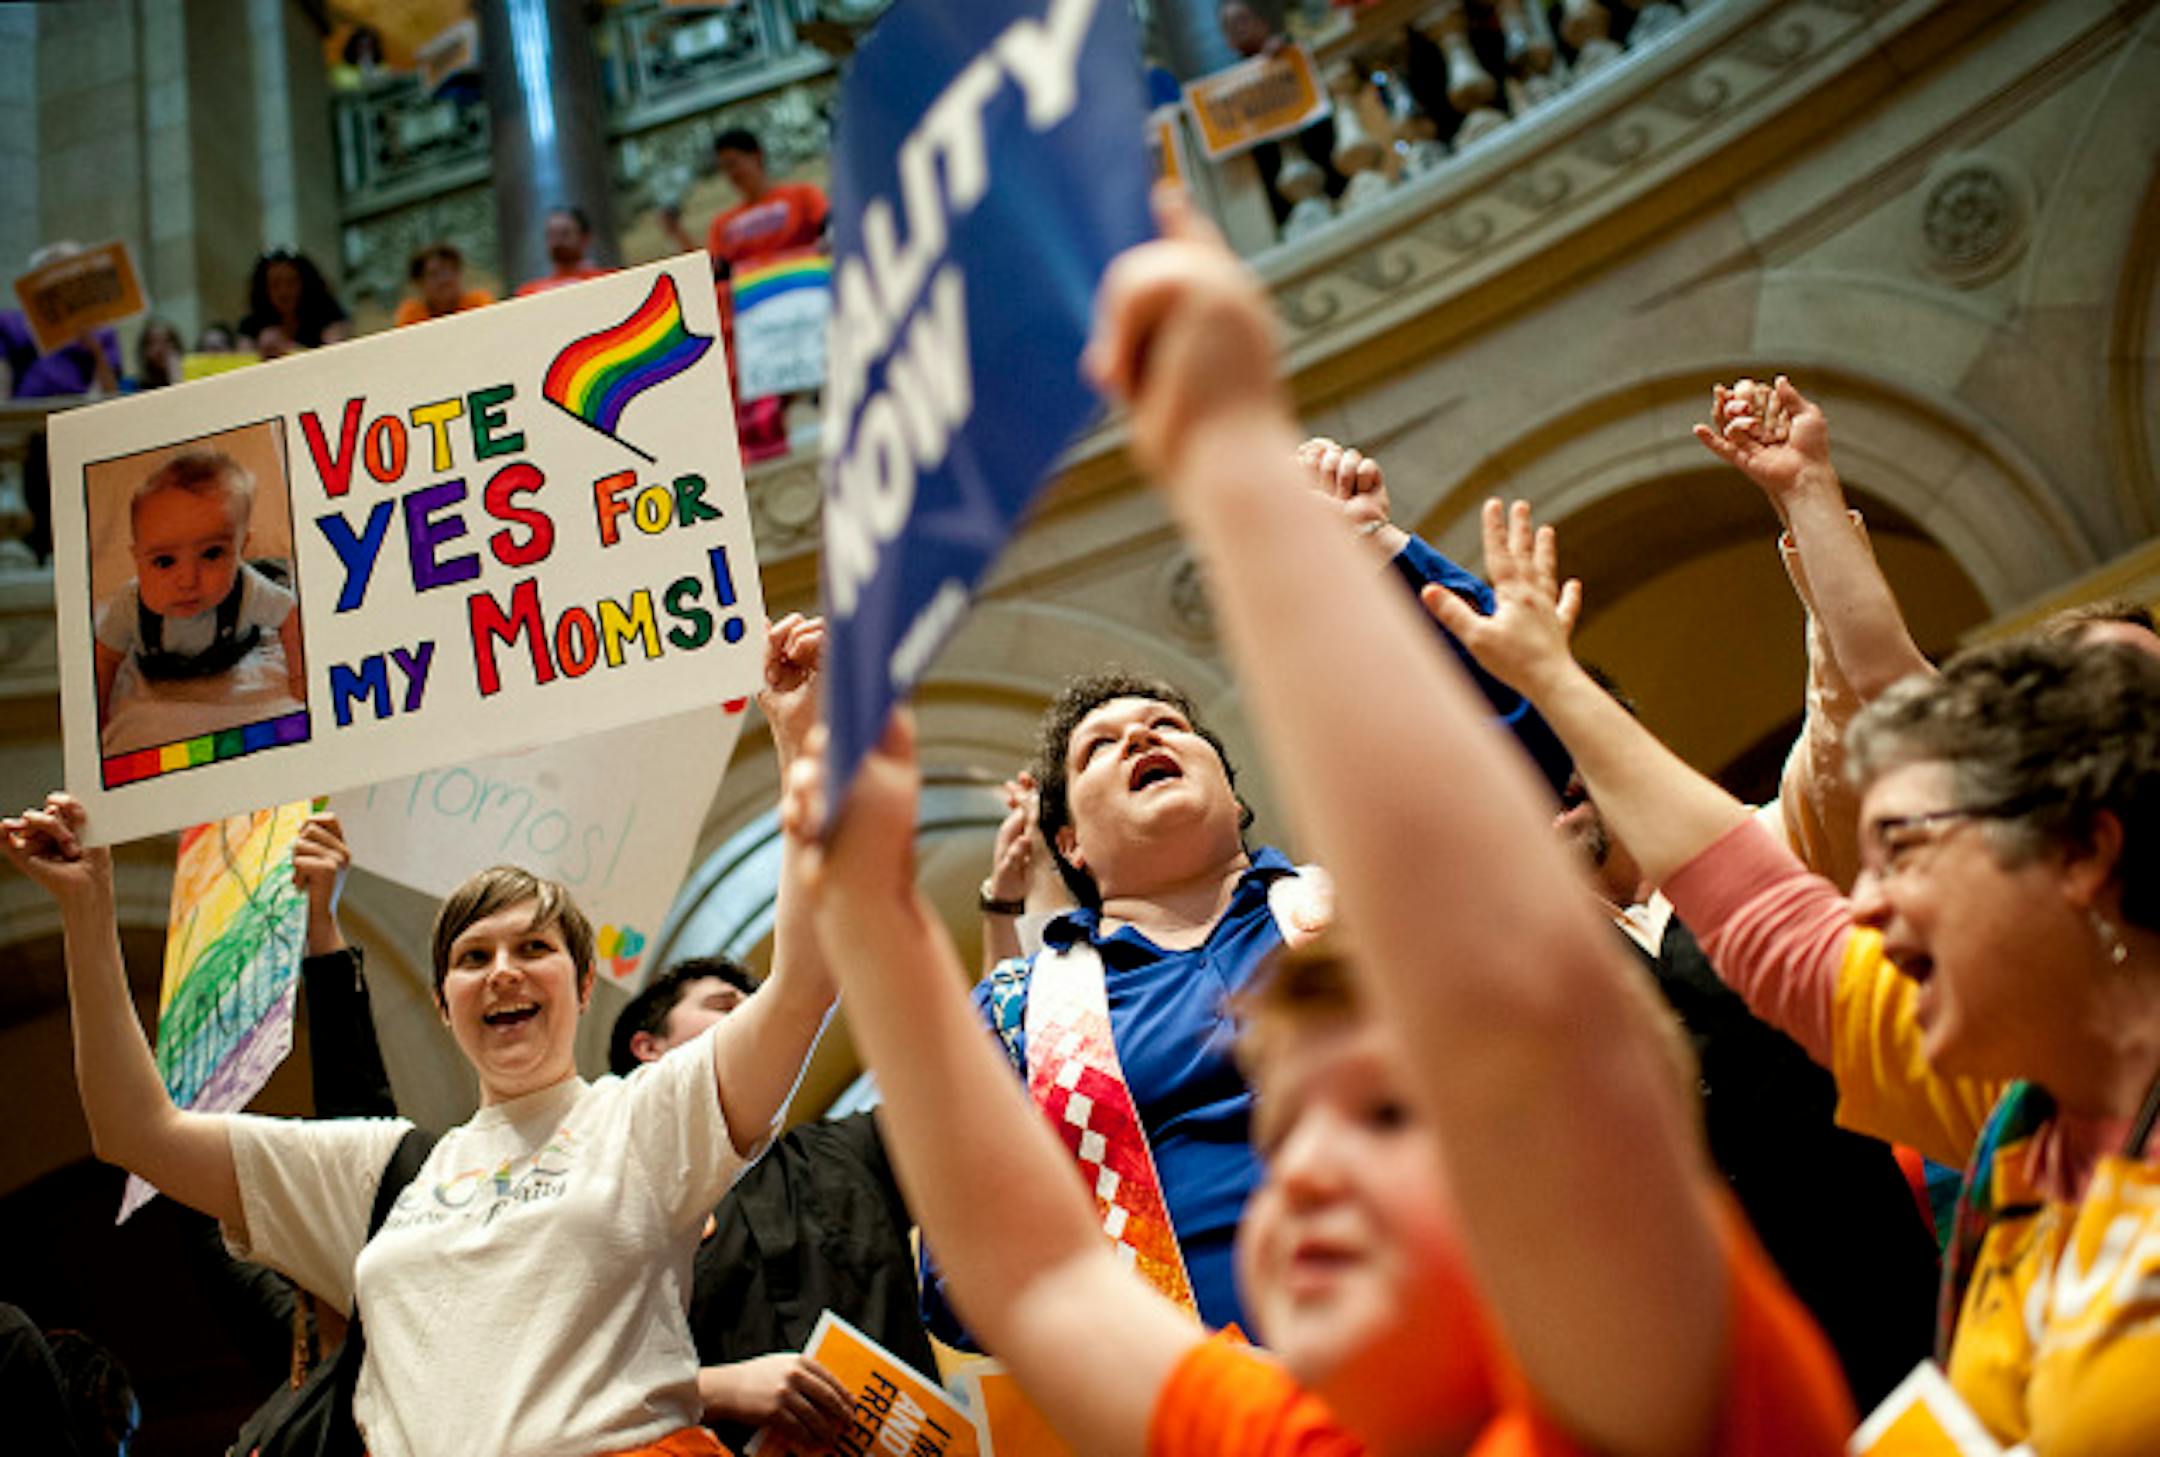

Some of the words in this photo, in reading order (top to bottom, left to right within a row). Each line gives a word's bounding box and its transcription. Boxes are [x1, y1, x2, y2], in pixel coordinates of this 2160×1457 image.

[300, 385, 524, 498] VOTE
[824, 262, 973, 617] NOW
[316, 462, 555, 613] YES
[592, 470, 723, 547] FOR
[329, 640, 435, 728] MY
[467, 546, 746, 698] MOMS!
[879, 1391, 928, 1457] AND
